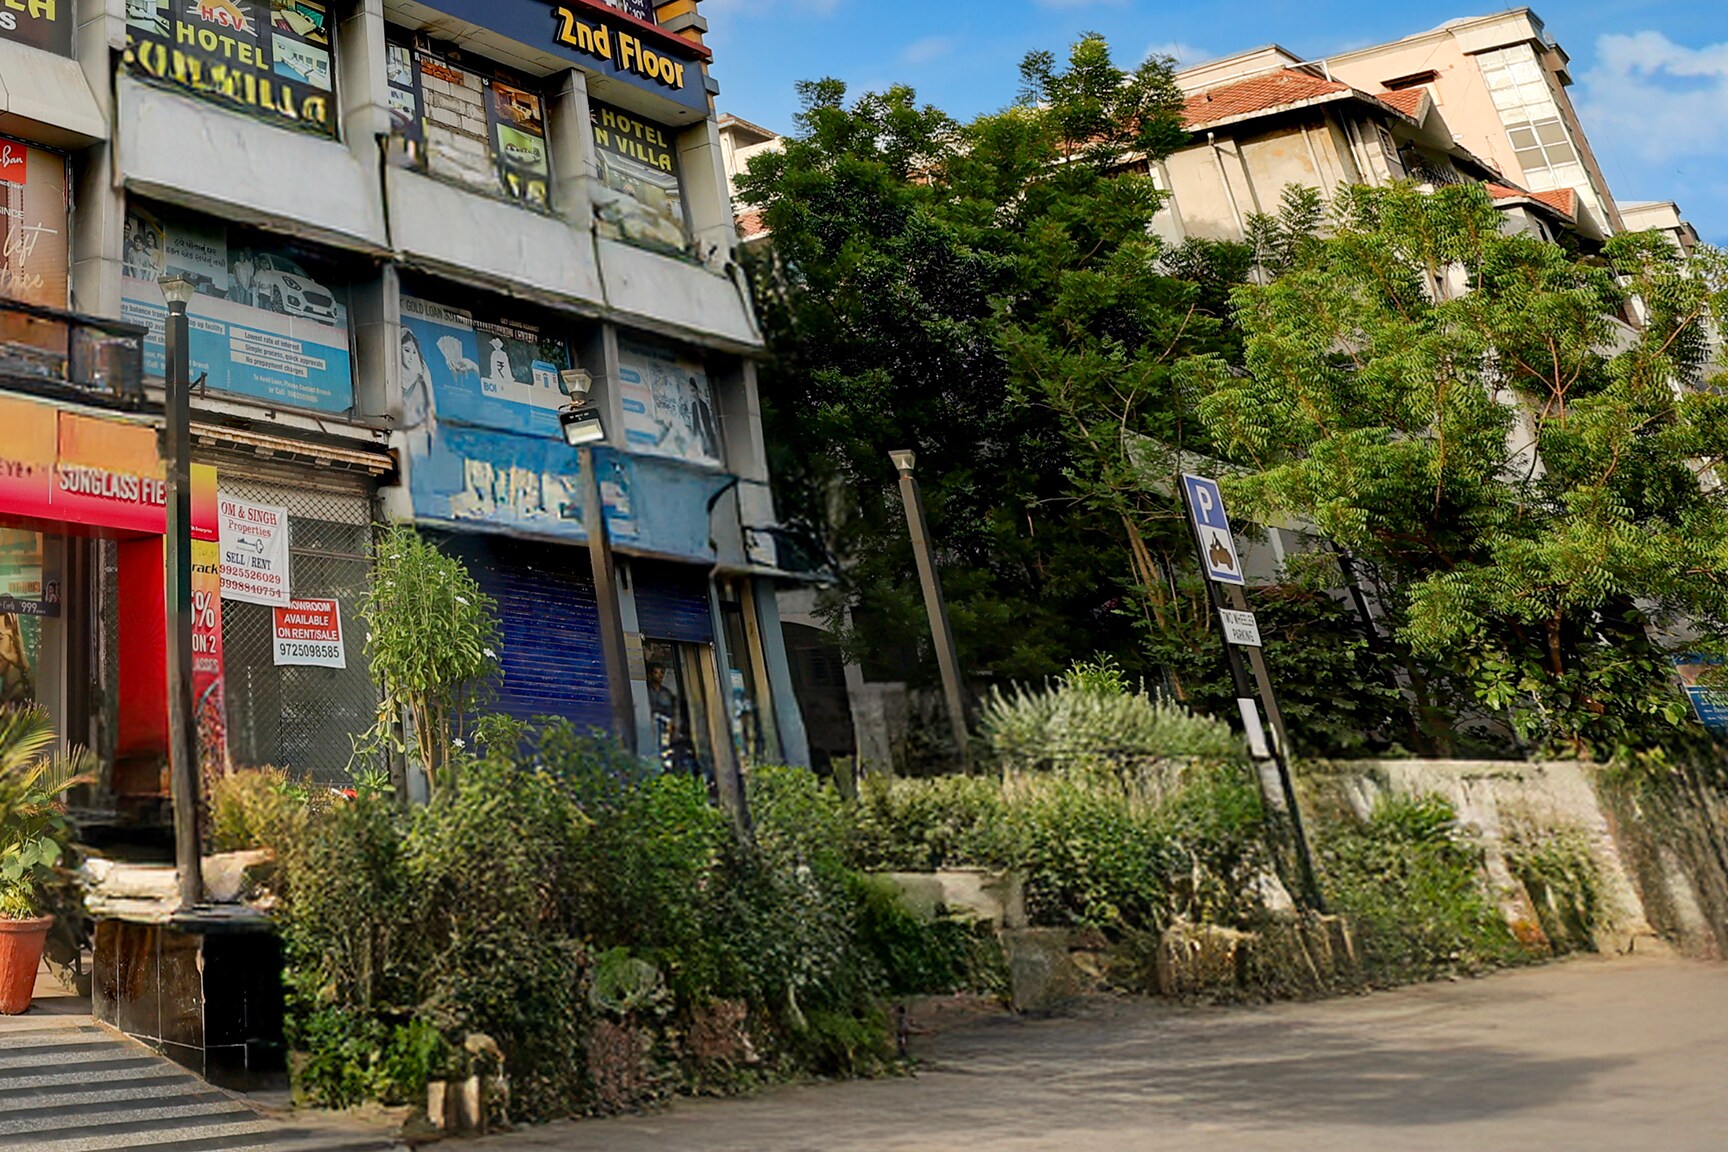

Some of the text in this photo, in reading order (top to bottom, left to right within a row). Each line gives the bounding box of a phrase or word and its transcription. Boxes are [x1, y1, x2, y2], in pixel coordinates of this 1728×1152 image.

[201, 5, 243, 32] HSV
[176, 20, 270, 71] HOTEL
[558, 6, 684, 89] 2nd Floor
[601, 108, 668, 149] HOTEL
[615, 134, 673, 172] VILLA
[3, 222, 58, 267] left
[130, 305, 152, 316] balance
[405, 299, 423, 316] GOLD
[425, 303, 443, 320] LOAN
[244, 331, 263, 342] Lowest
[263, 336, 274, 345] rate
[280, 340, 300, 351] interest
[245, 343, 263, 355] Simple
[245, 356, 304, 376] No prepayment charges
[60, 465, 168, 505] SUNGLASS FIE
[221, 501, 278, 526] OM & SINGH
[1196, 486, 1214, 523] P
[228, 519, 272, 538] Properties
[226, 551, 245, 566] SELL
[251, 556, 272, 571] RENT
[219, 563, 282, 585] 9925526029
[284, 615, 329, 626] AVAILABLE
[278, 627, 338, 641] ON RENT/SALE
[1232, 628, 1255, 643] PARKING
[209, 635, 217, 654] 2
[280, 642, 341, 659] 9725098585
